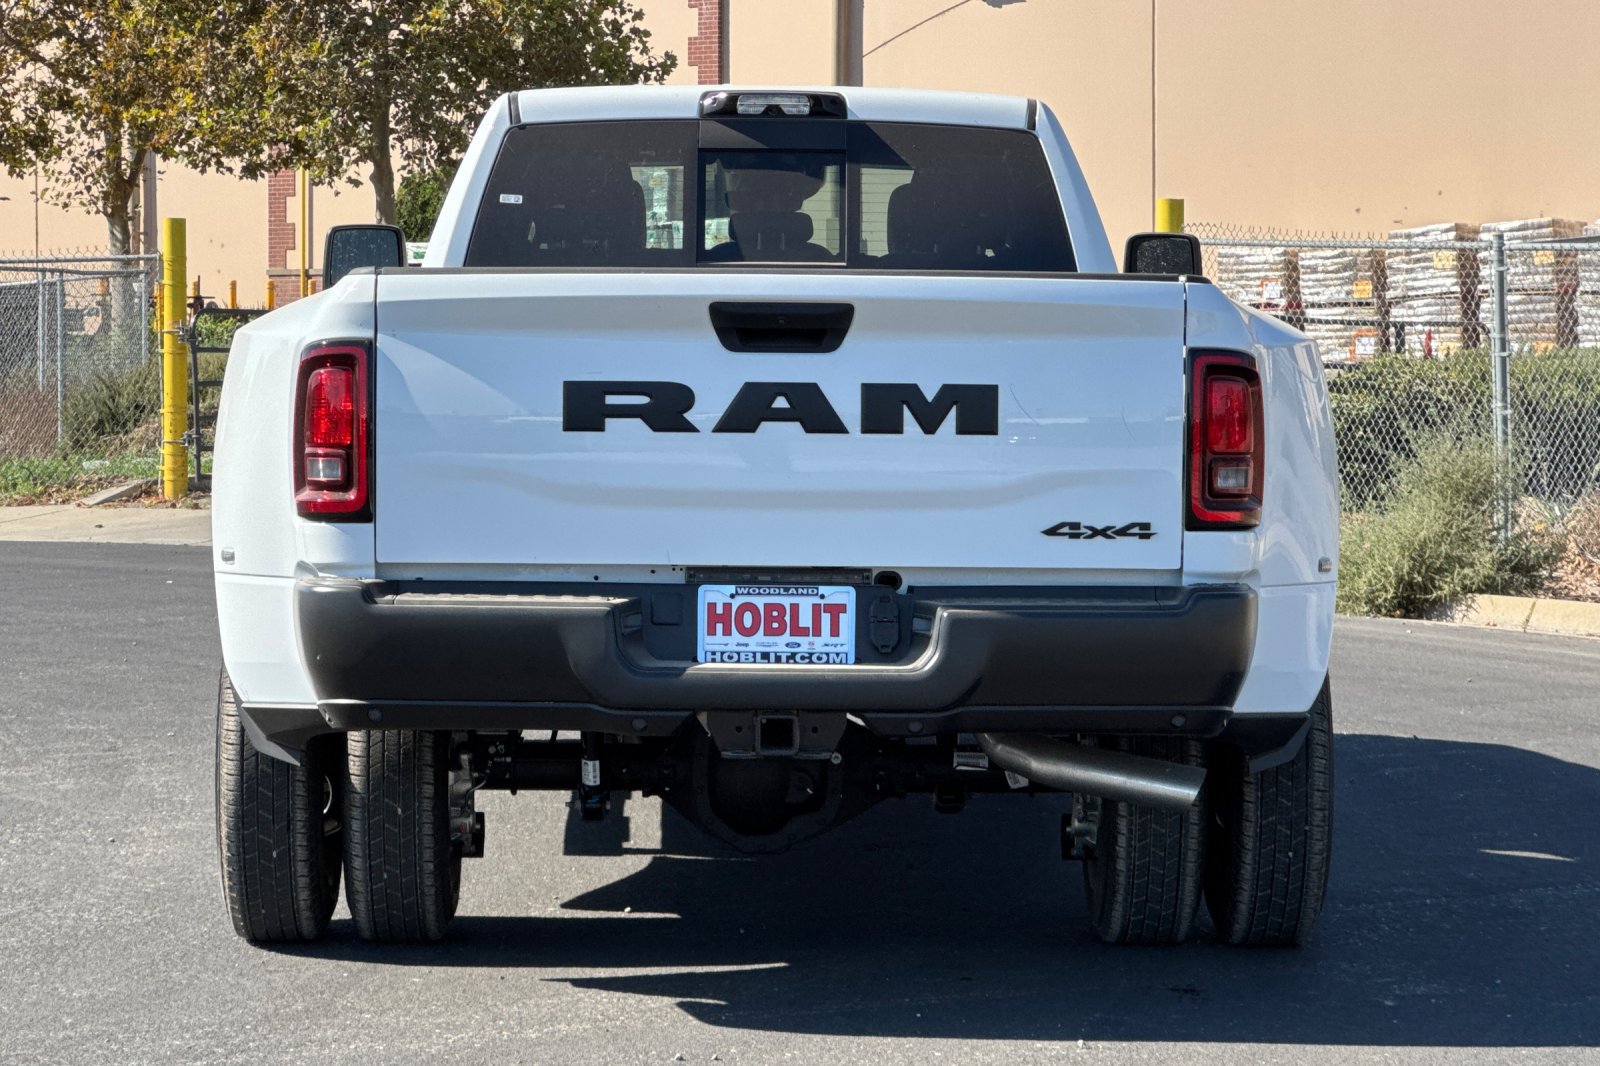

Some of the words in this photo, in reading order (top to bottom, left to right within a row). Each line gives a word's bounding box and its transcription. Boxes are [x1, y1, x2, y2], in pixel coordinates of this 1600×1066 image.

[563, 380, 998, 435] RAM
[1040, 521, 1158, 539] 4x4
[736, 587, 818, 595] WOODLAND
[706, 602, 847, 637] HOBLIT
[705, 651, 847, 664] HOBLIT.COM
